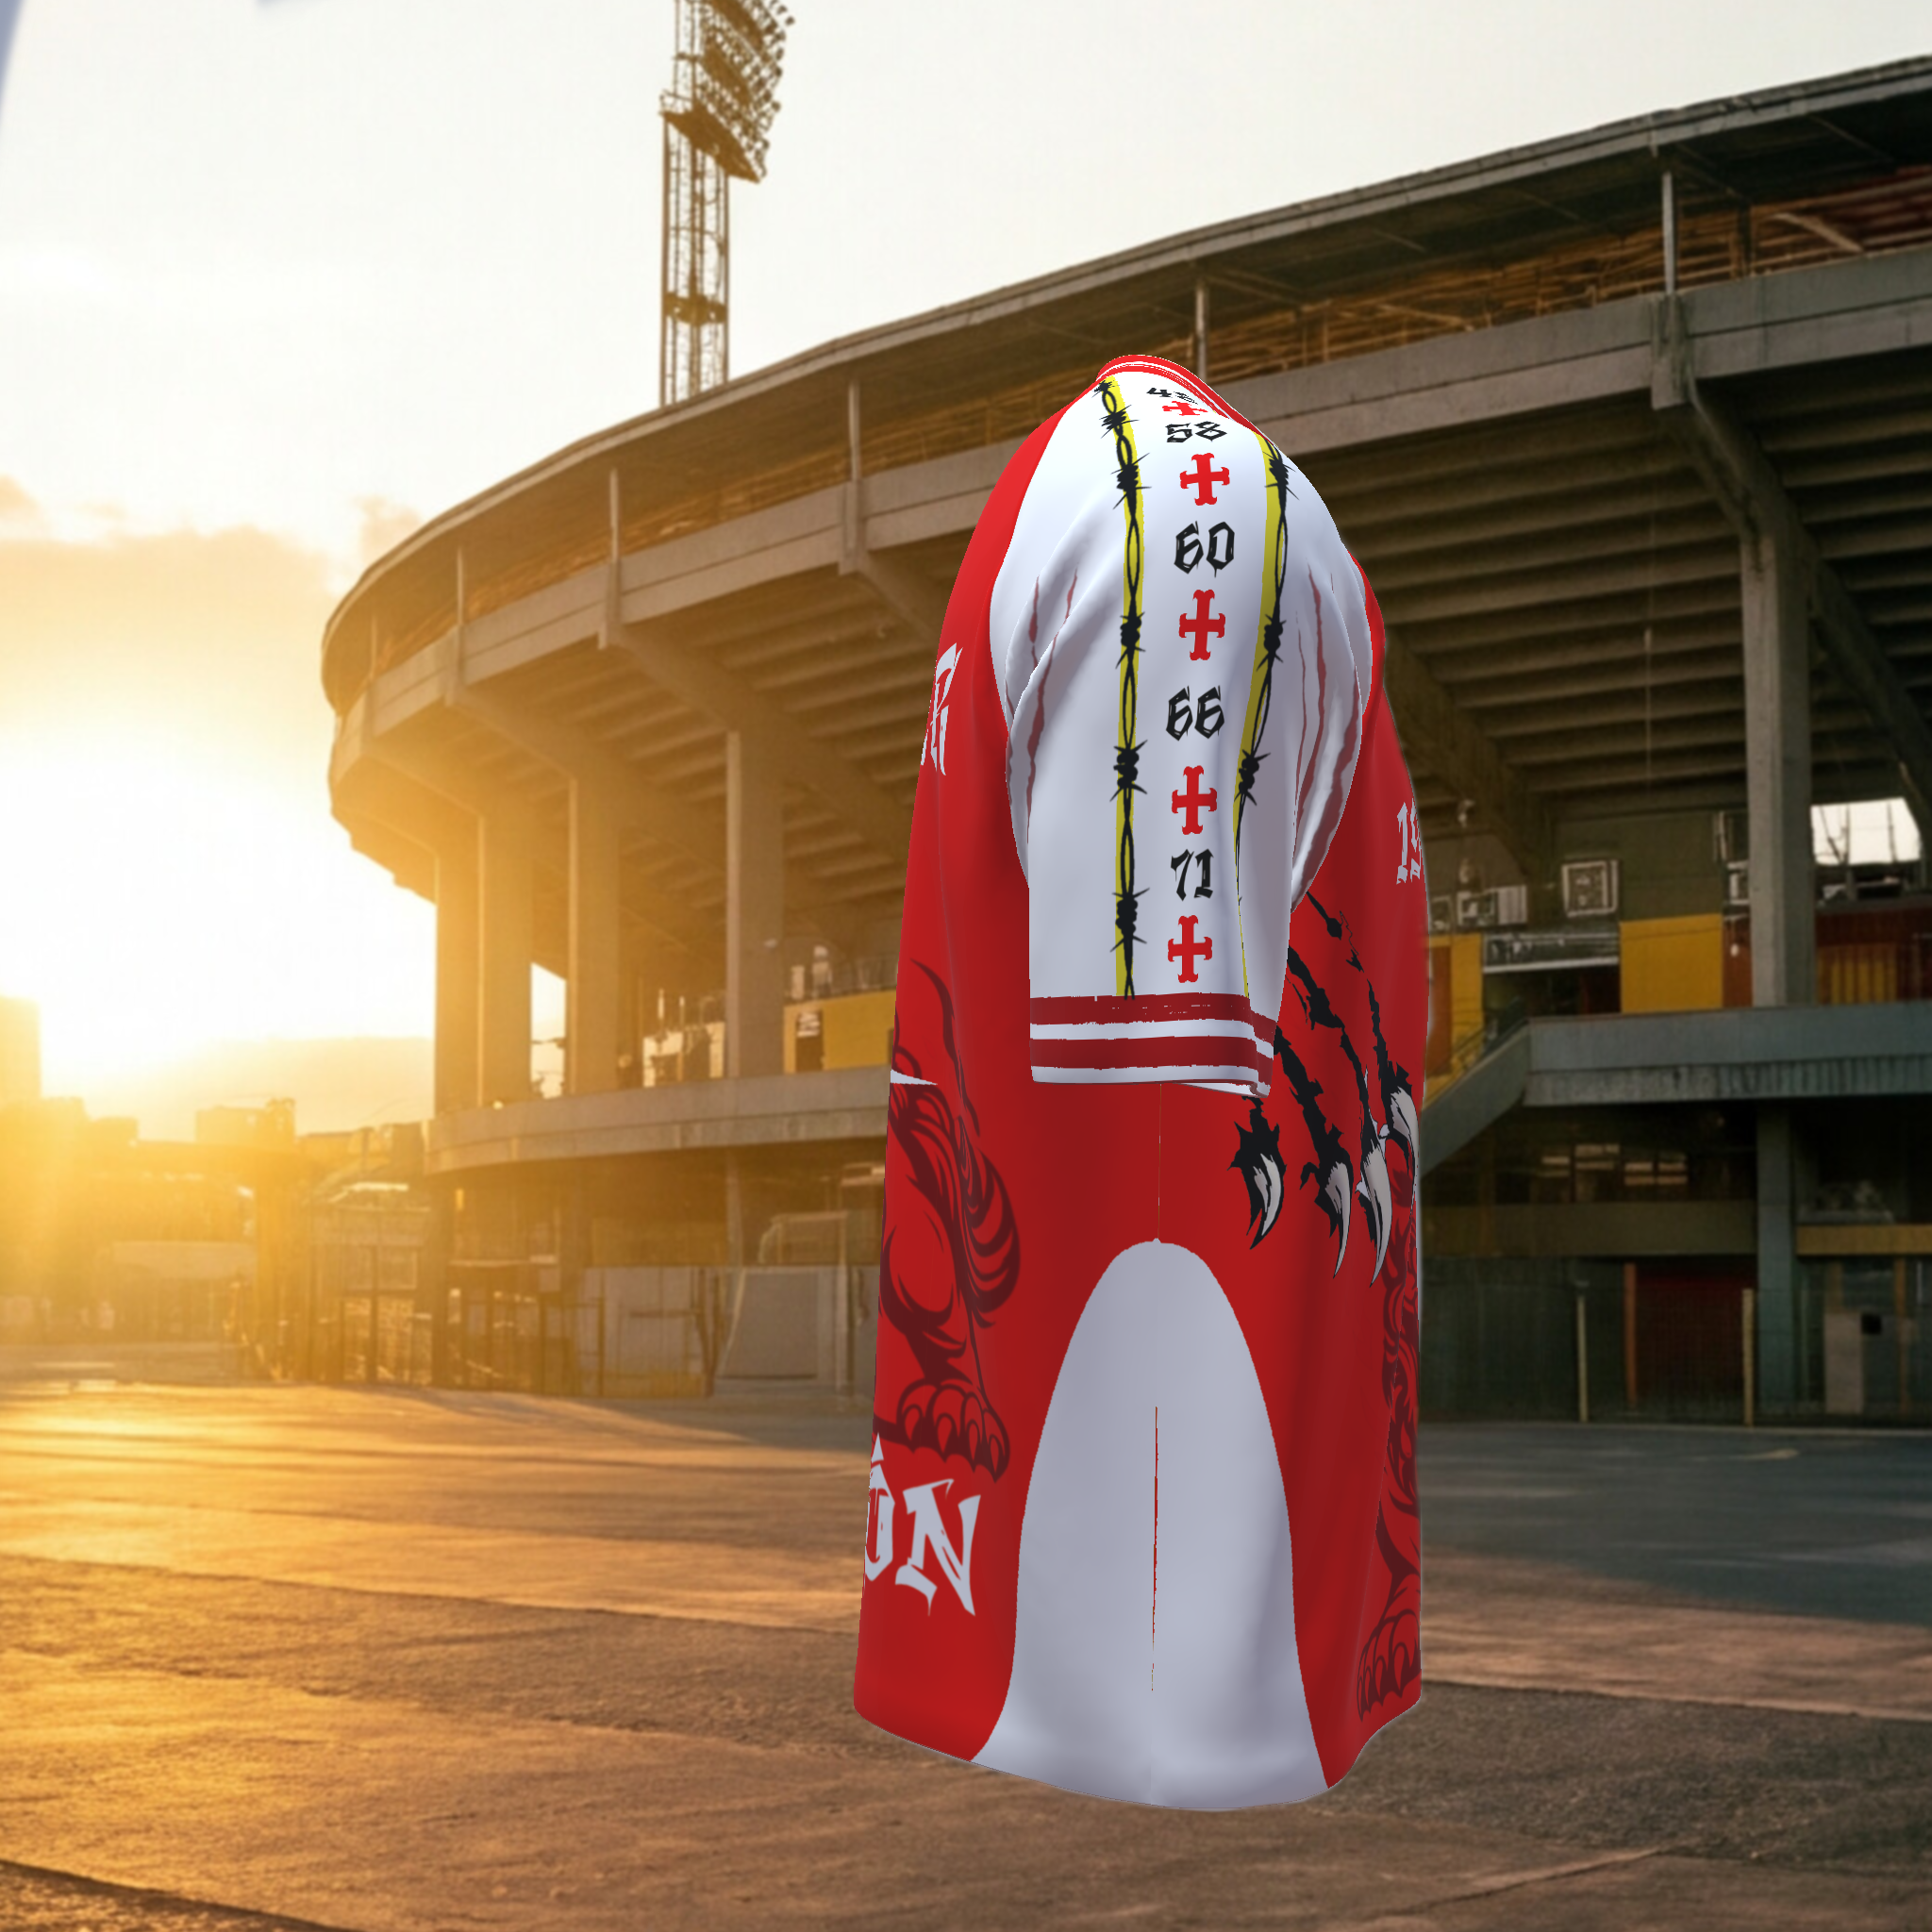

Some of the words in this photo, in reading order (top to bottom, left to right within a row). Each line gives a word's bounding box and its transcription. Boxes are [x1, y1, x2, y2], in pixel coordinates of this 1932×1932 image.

[1165, 421, 1227, 443] 58
[1174, 521, 1235, 576] 60
[1165, 685, 1225, 741] 66
[1170, 848, 1214, 902] 71
